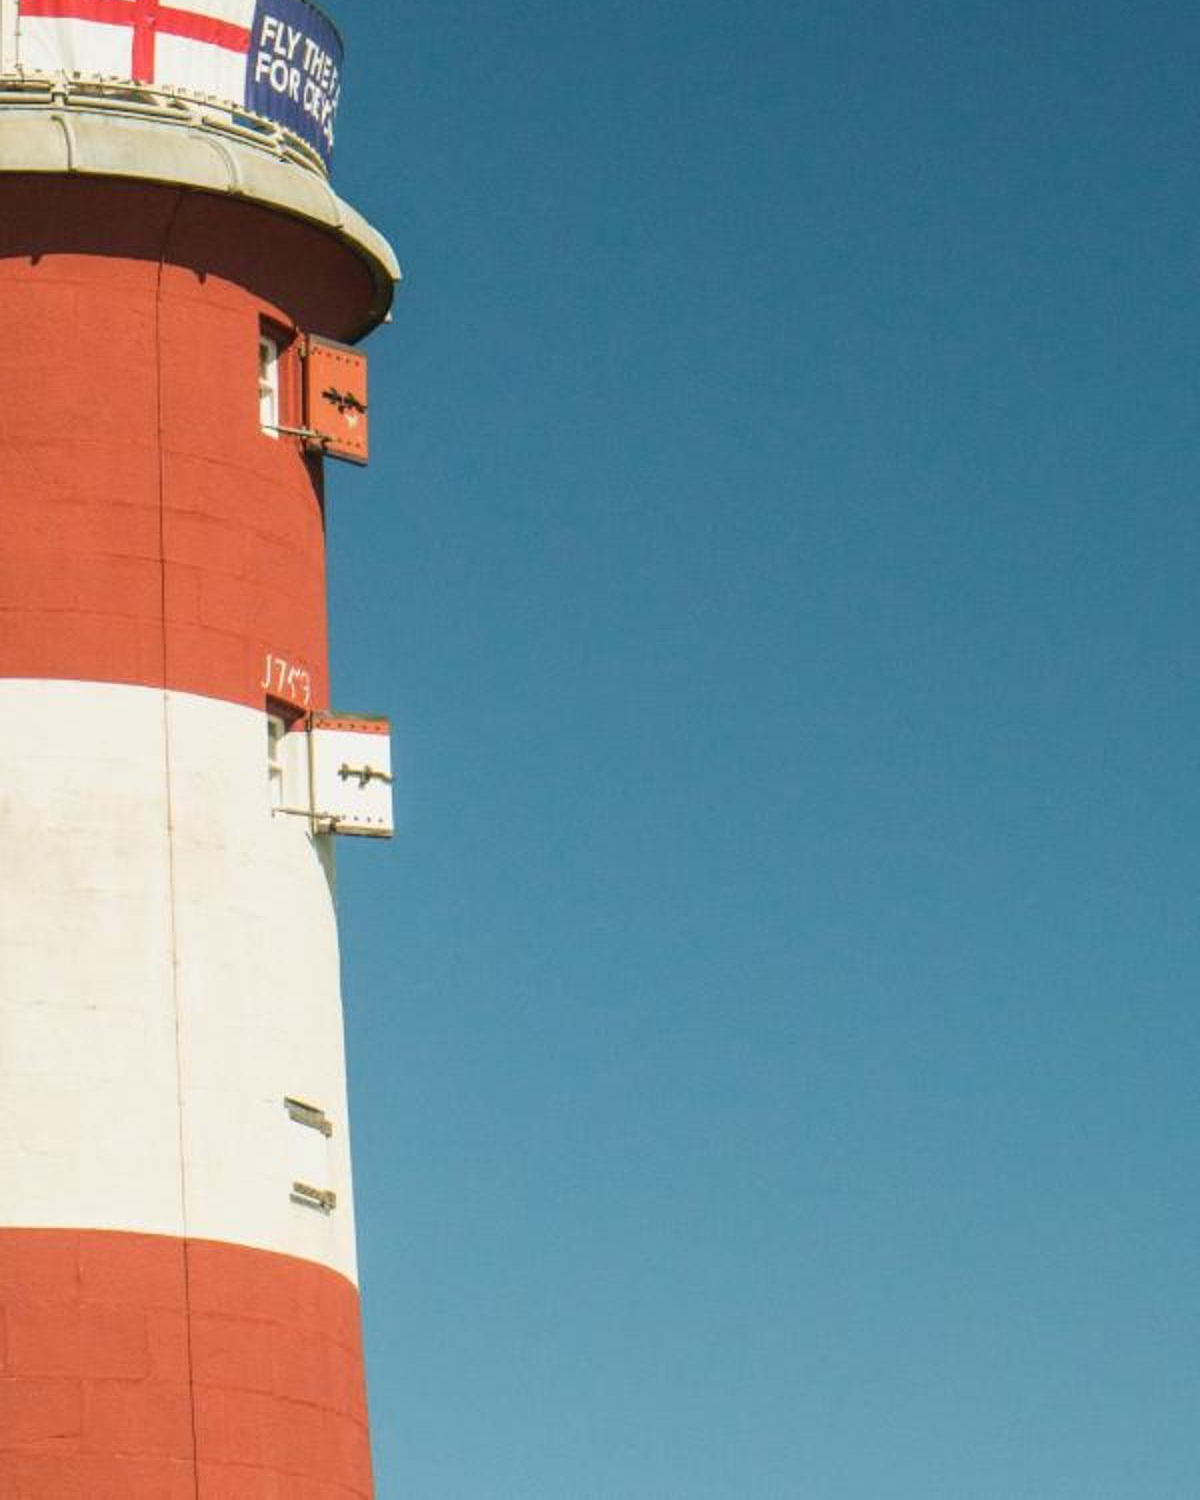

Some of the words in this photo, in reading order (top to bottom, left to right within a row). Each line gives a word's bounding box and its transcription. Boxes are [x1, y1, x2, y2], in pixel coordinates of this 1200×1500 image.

[255, 51, 301, 103] FOR
[260, 14, 302, 61] FLY
[302, 37, 333, 88] THE
